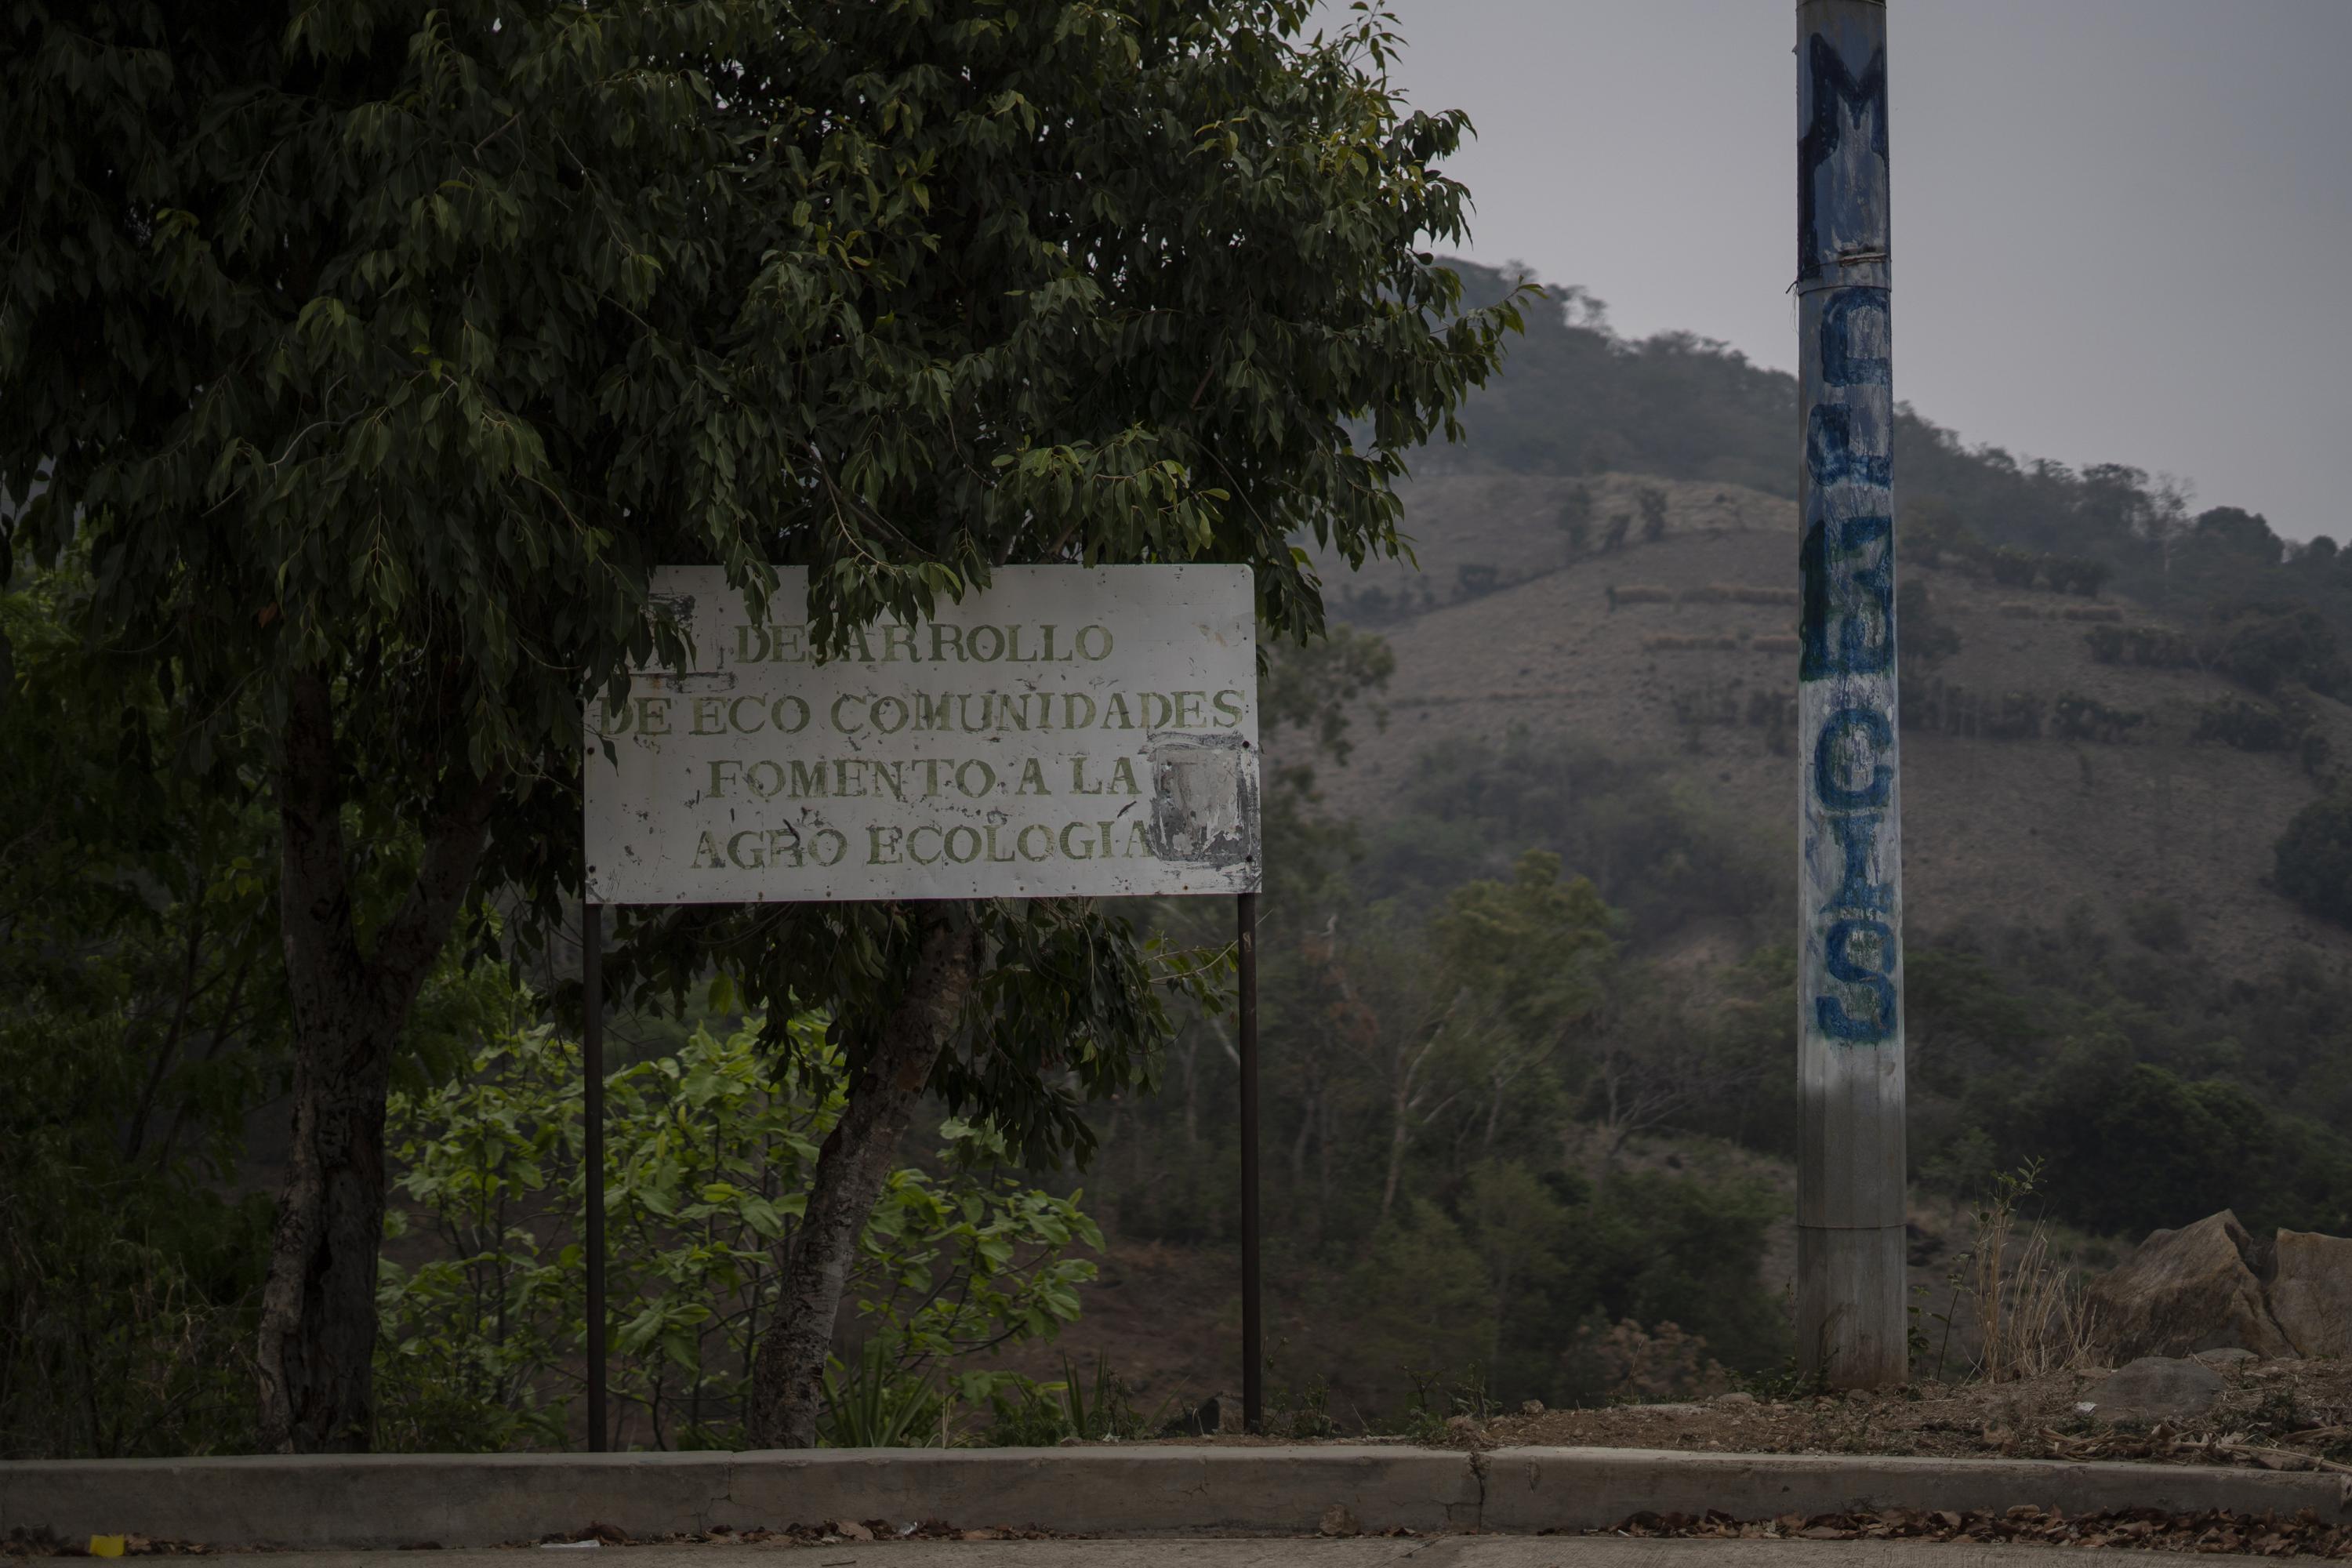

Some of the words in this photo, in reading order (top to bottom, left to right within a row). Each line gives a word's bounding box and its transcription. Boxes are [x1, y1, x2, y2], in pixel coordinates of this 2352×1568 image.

[597, 696, 673, 735] DE
[688, 695, 811, 735] ECO
[830, 690, 1245, 735] COMUNIDADES
[706, 758, 996, 799] FOMENTO
[1016, 757, 1051, 796] A
[1069, 757, 1142, 795] LA
[690, 827, 848, 870] AGRO
[866, 820, 1156, 865] ECOLOGIA
